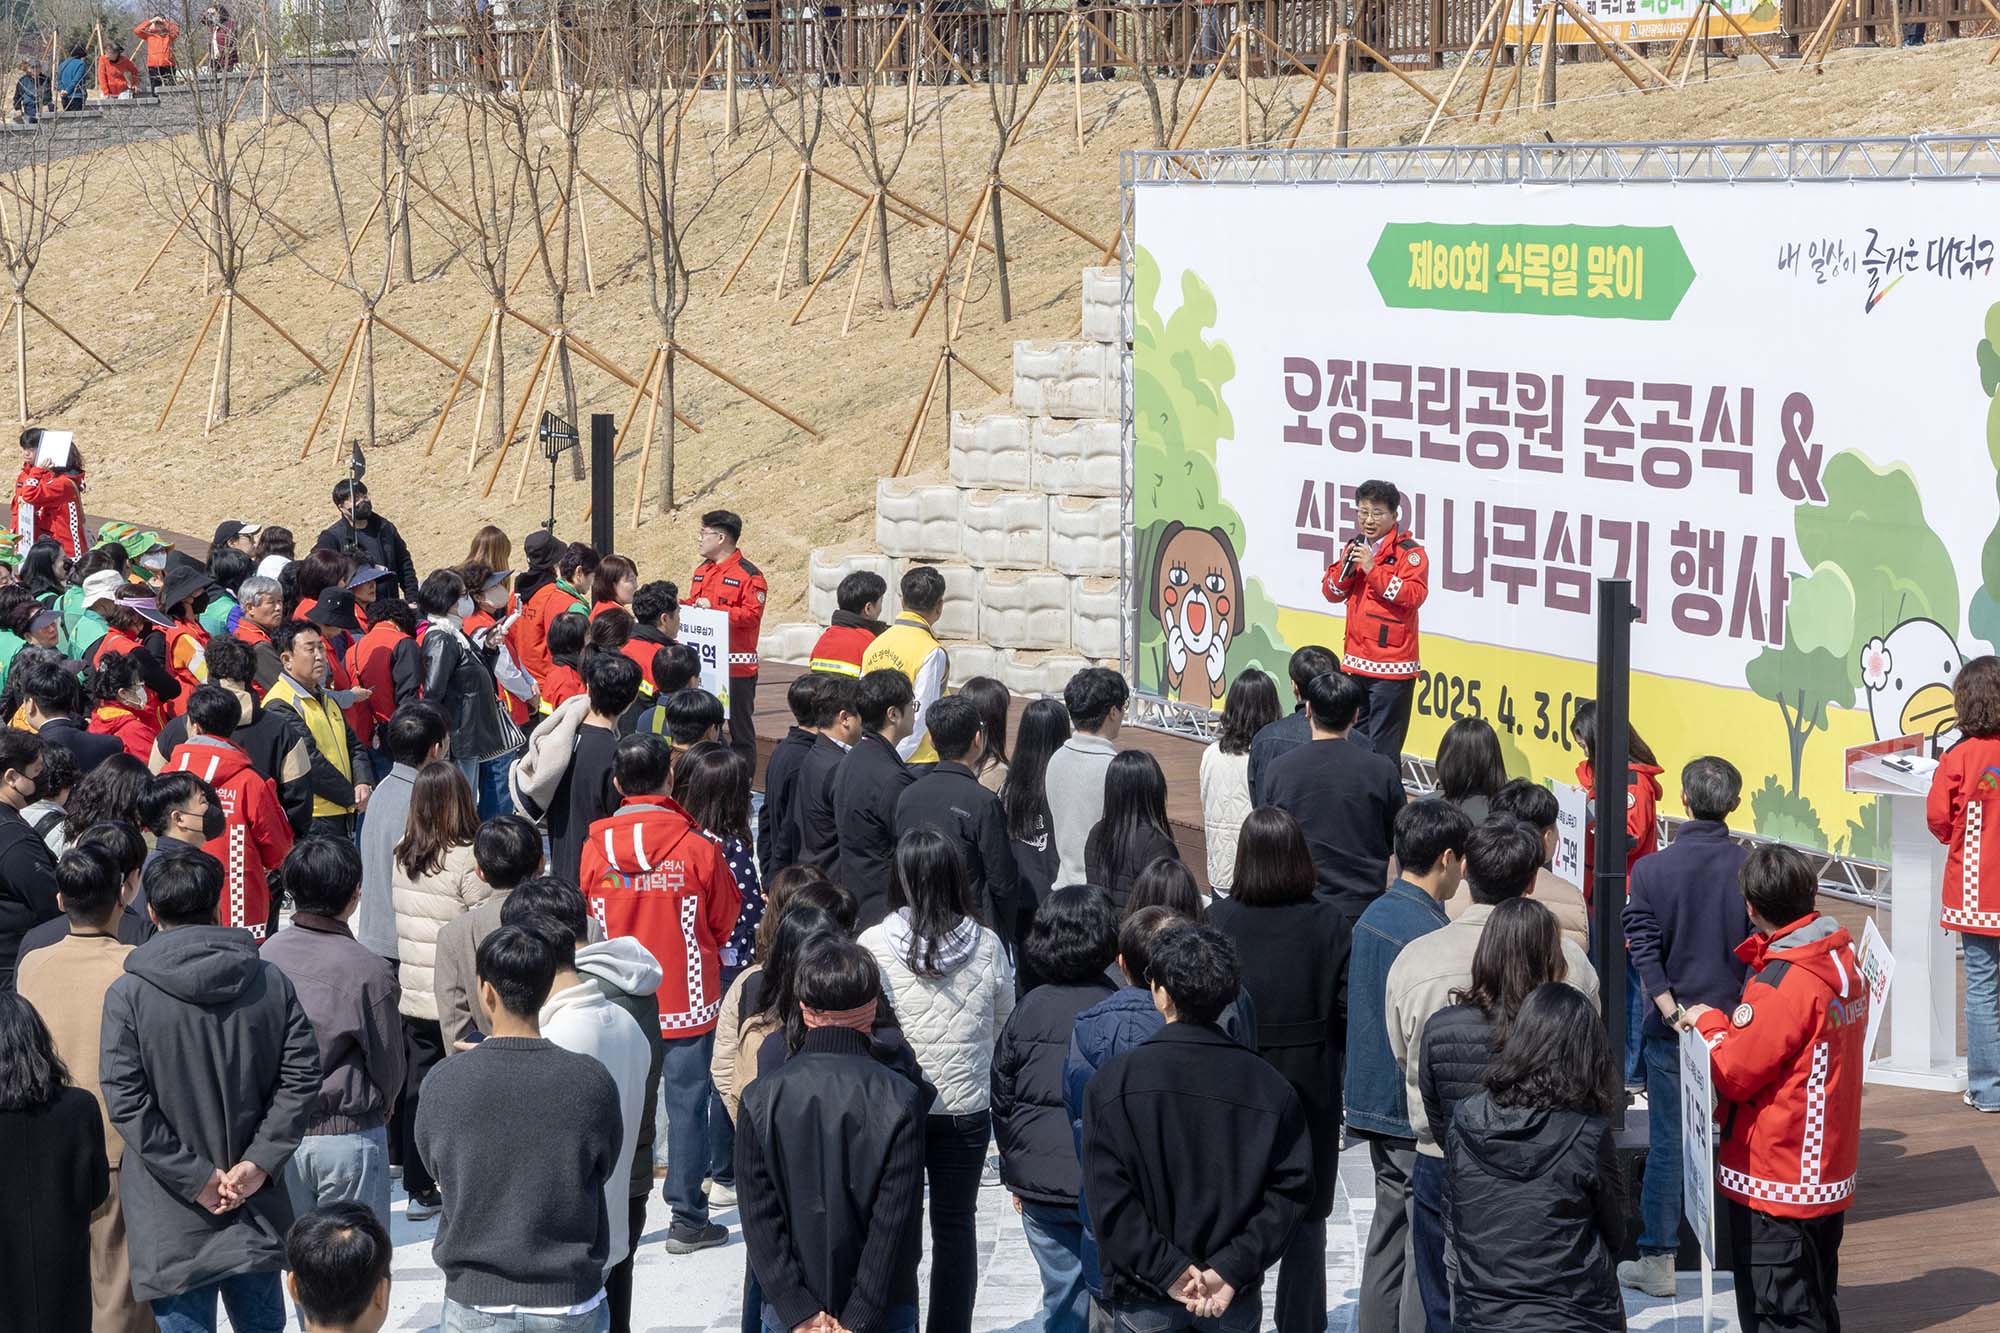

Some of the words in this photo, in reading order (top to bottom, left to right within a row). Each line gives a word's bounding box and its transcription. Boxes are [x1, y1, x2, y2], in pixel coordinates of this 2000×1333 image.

[1408, 240, 1489, 294] 제80회
[1496, 242, 1578, 296] 식목일
[1587, 245, 1643, 300] 맞이
[1778, 242, 1801, 277] 내
[1808, 238, 1856, 284] 일상이
[1862, 228, 1919, 314] 즐거운
[1926, 234, 1995, 280] 대덕구
[1283, 357, 1564, 473] 오정근린공원
[1584, 378, 1754, 494] 준공식
[1776, 391, 1827, 501] &
[1442, 498, 1649, 624] 나무심기
[1670, 521, 1789, 645] 행사
[635, 873, 686, 892] 대덕구
